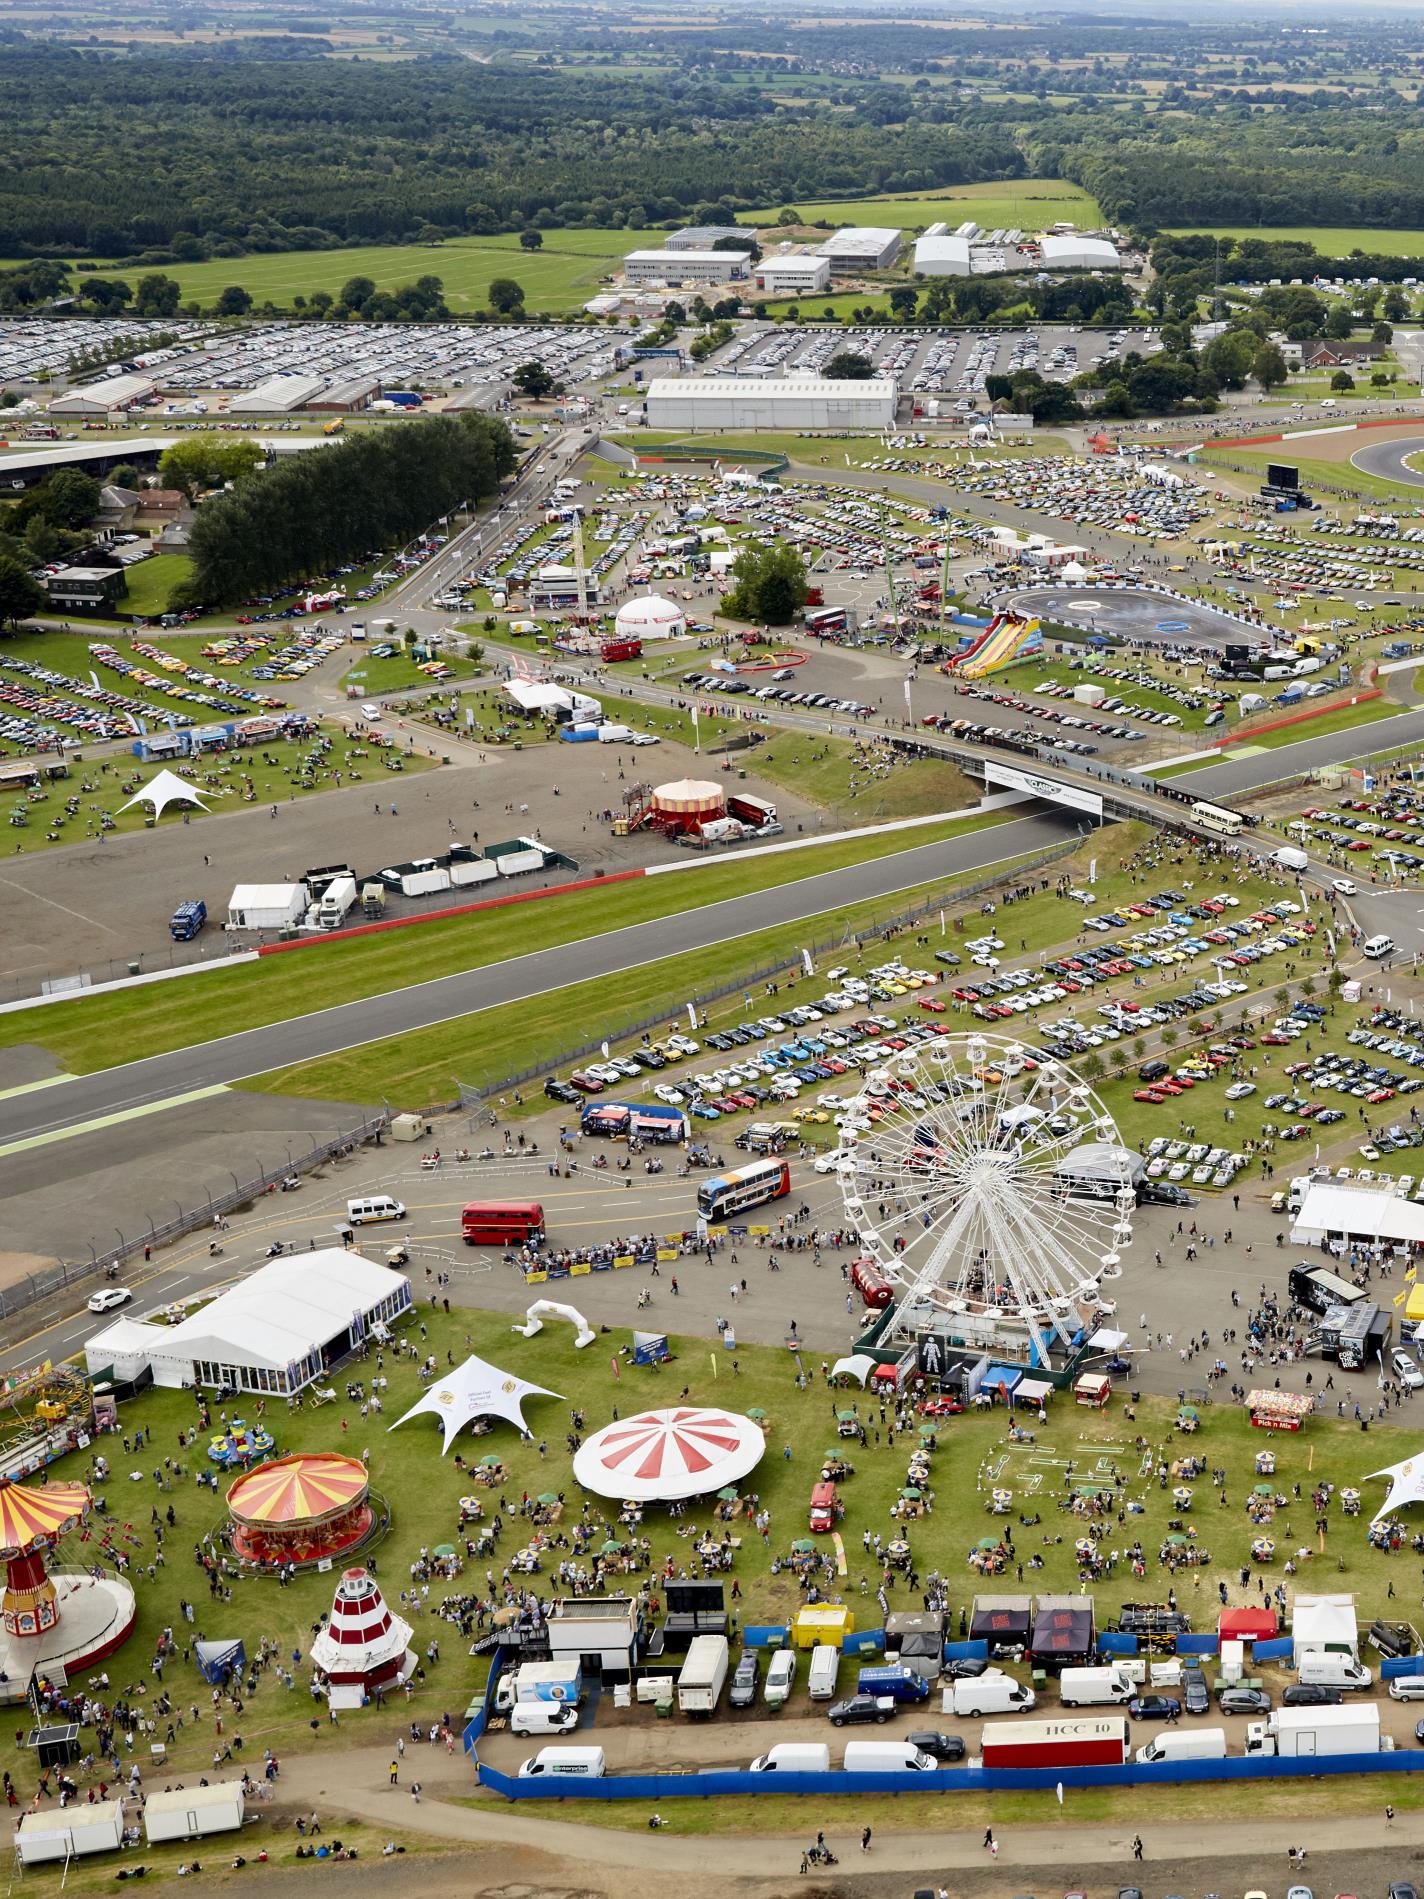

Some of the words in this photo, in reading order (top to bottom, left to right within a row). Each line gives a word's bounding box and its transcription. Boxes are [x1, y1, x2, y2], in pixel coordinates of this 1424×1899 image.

[1339, 1351, 1355, 1359] FOR
[1258, 1419, 1272, 1427] Pick
[1046, 1725, 1087, 1735] HCC
[1095, 1724, 1111, 1733] 10
